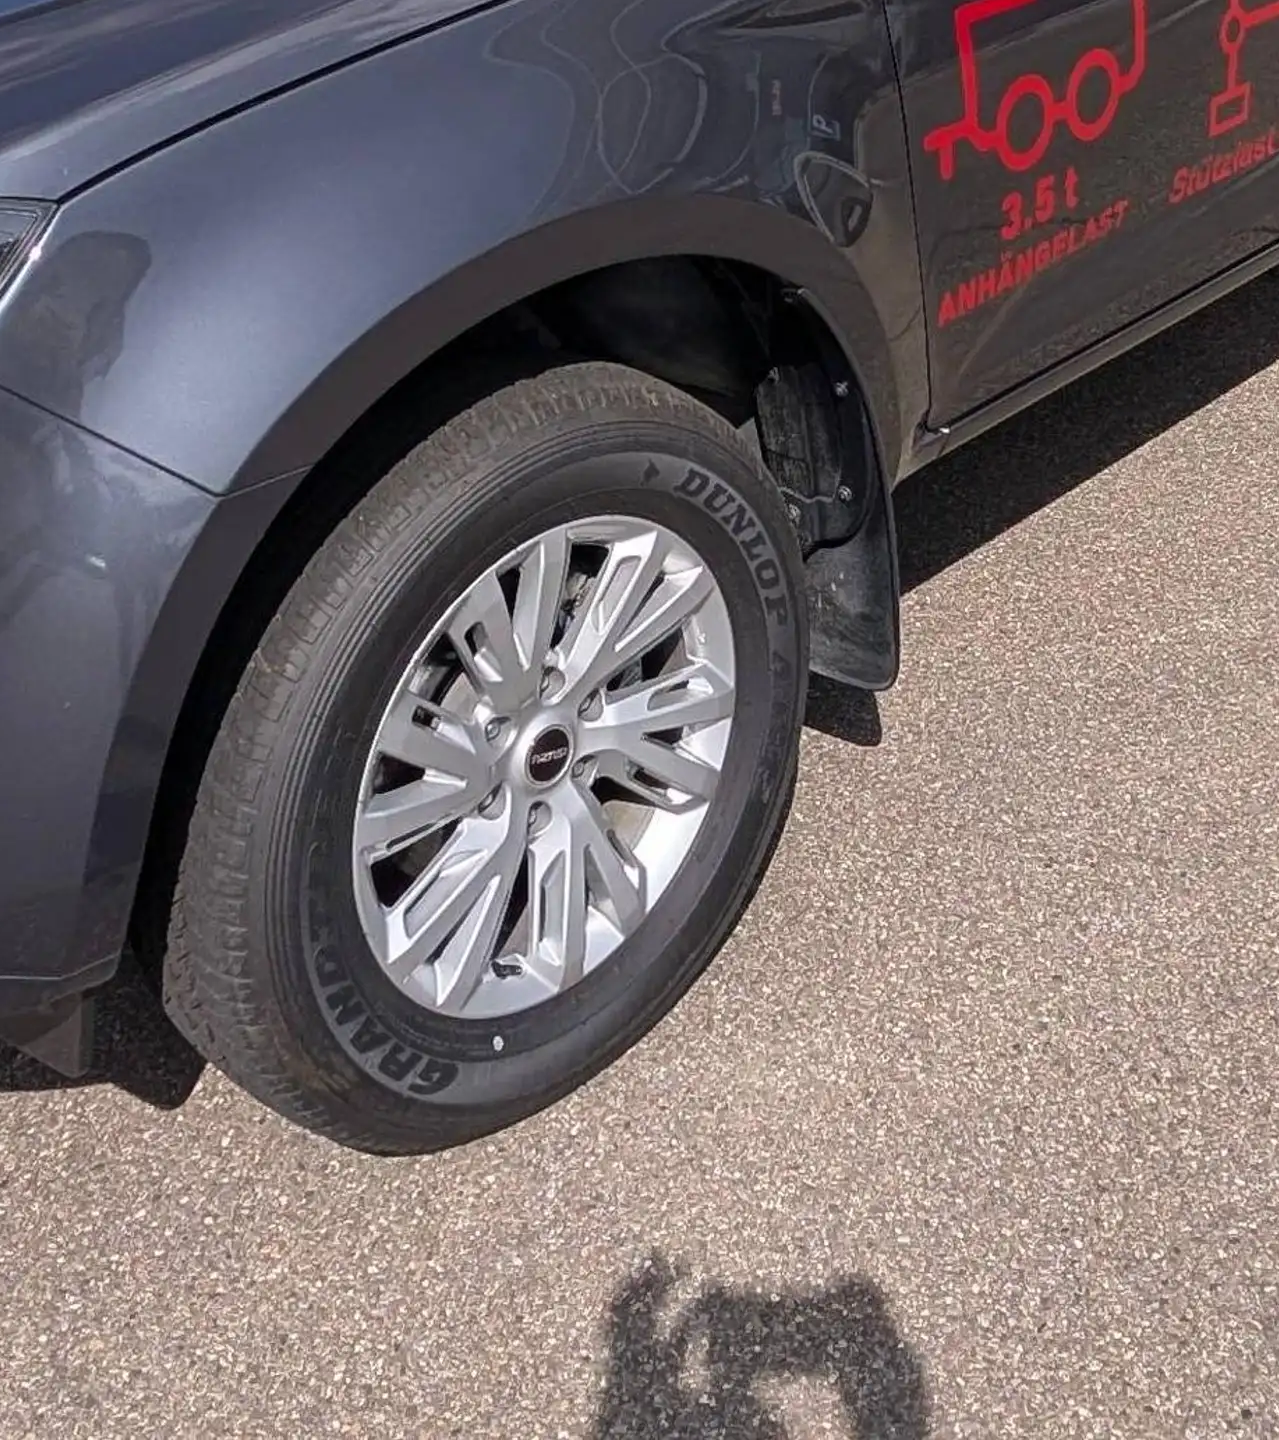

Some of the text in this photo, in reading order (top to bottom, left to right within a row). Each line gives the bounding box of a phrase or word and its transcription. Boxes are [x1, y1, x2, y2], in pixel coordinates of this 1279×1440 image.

[1064, 165, 1080, 208] t
[938, 199, 1129, 329] ANHÄNGELAST
[673, 467, 790, 627] DUNLOP
